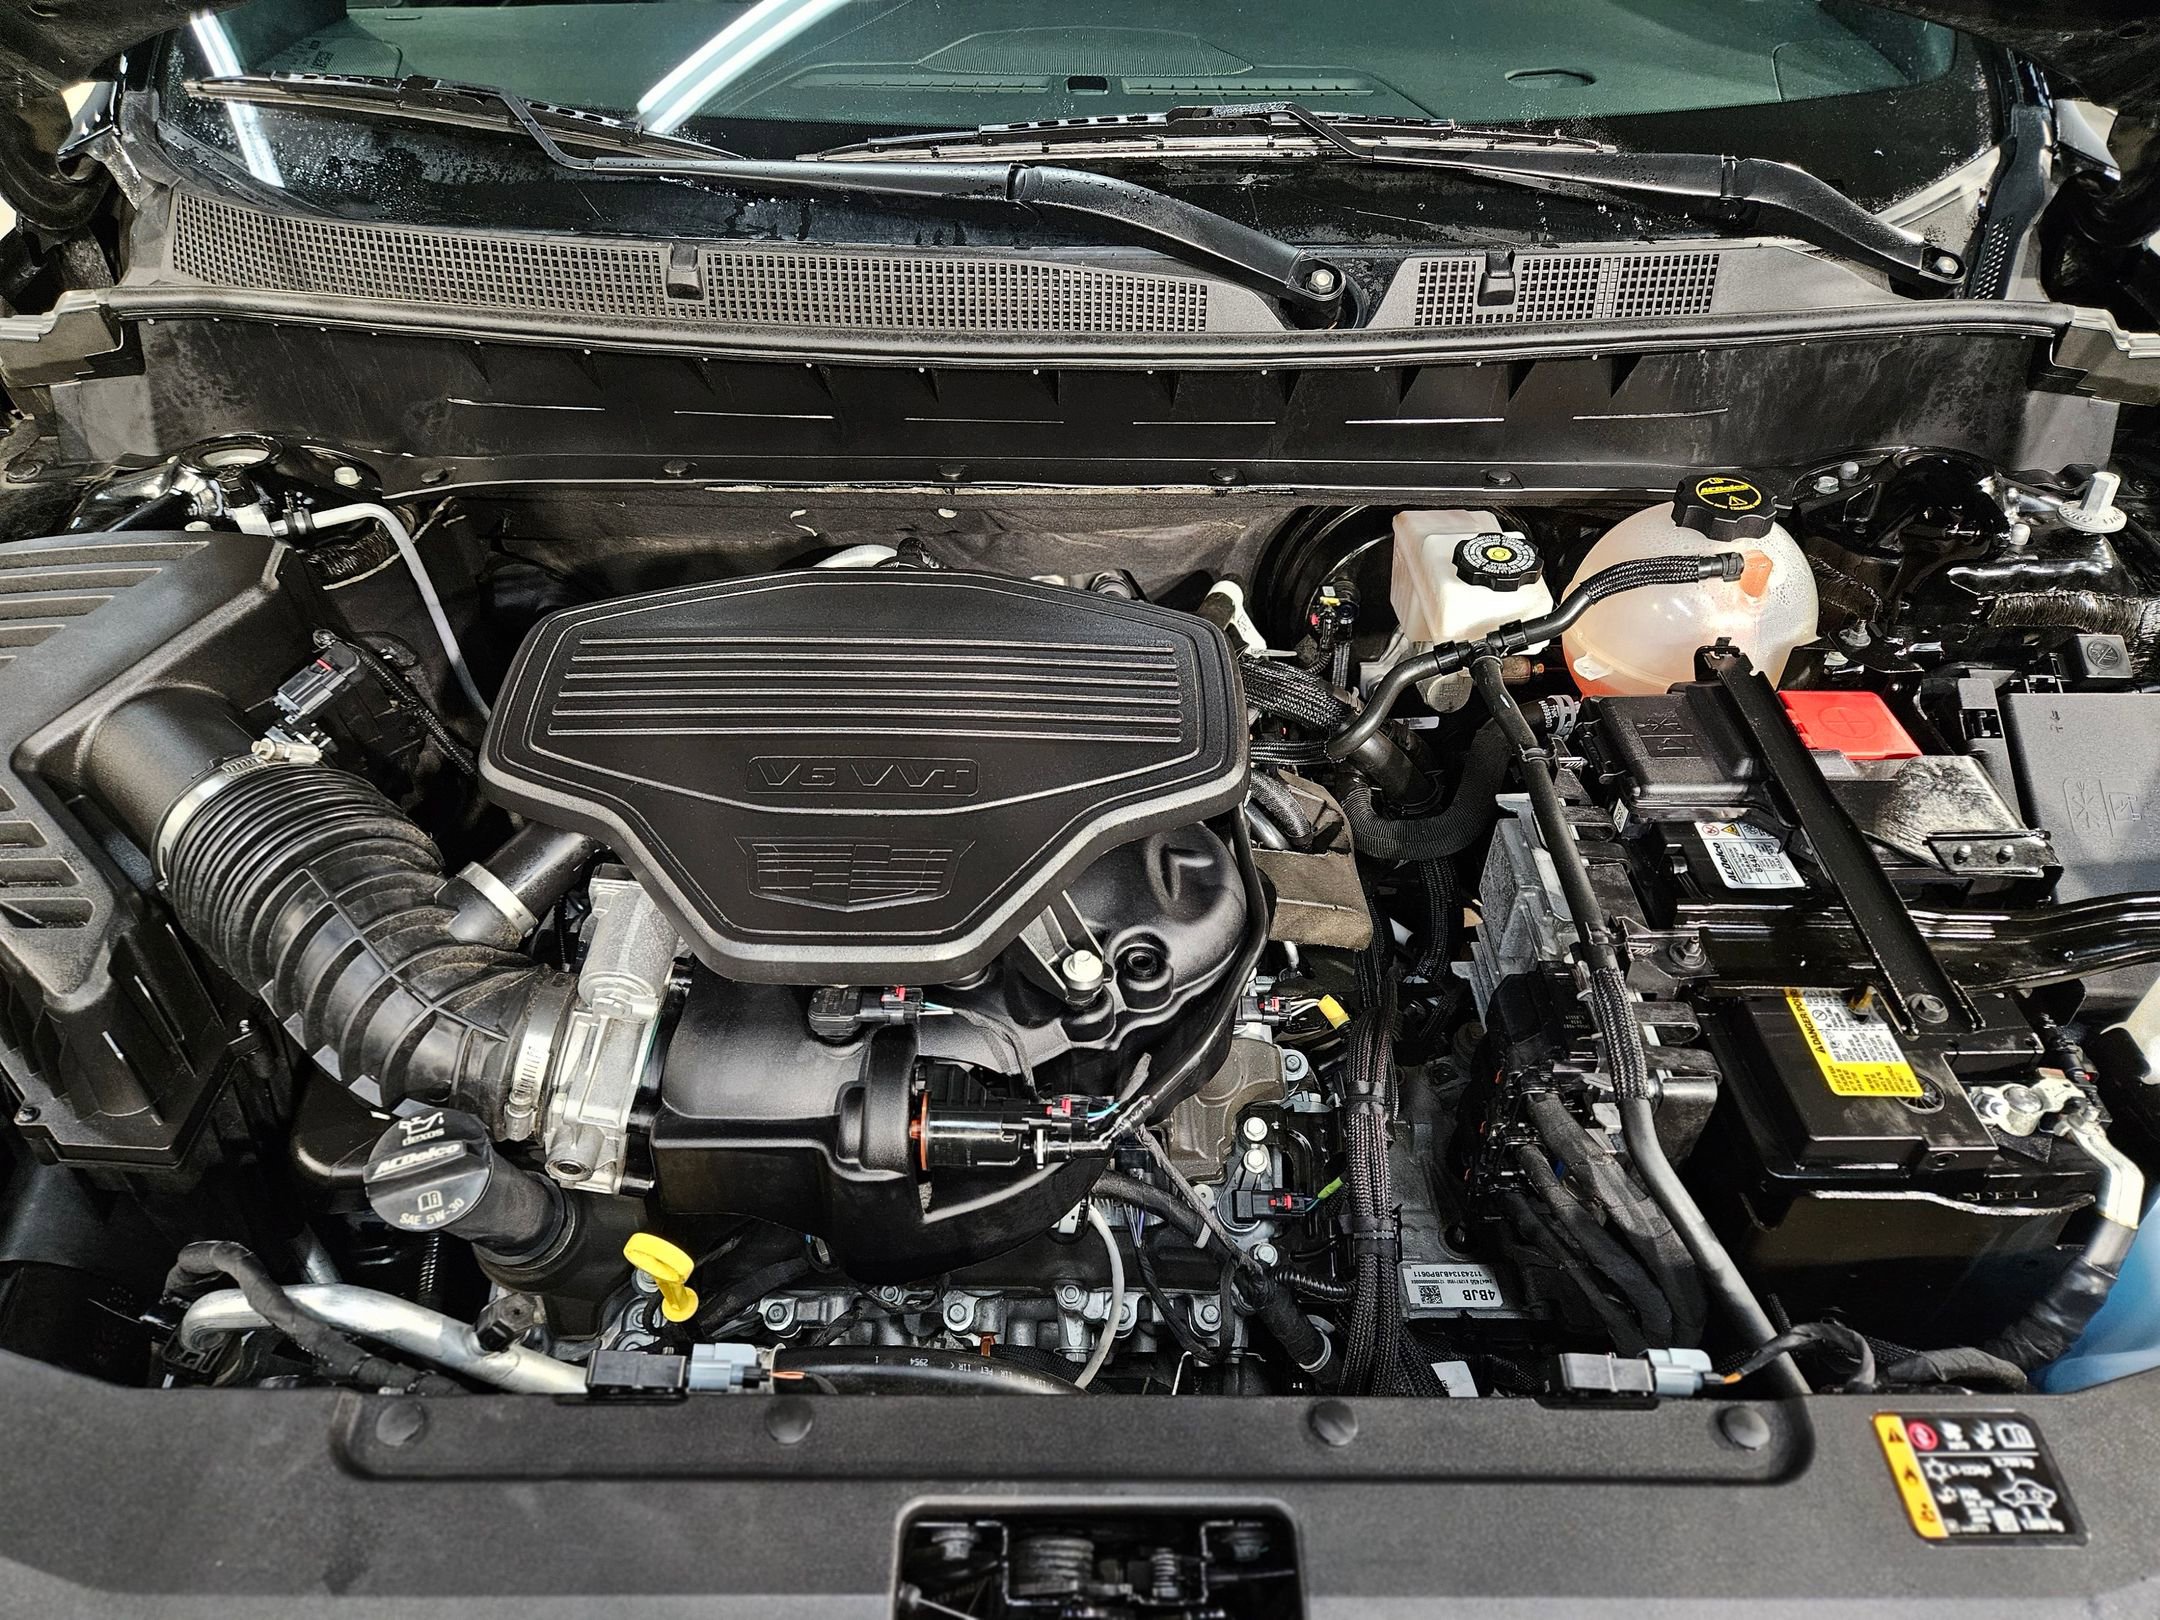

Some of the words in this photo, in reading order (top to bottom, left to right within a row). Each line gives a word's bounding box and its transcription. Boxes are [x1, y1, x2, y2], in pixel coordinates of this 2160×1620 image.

[757, 763, 837, 787] V6
[850, 763, 970, 789] VVT
[1712, 842, 1739, 883] ACDelco
[402, 1128, 445, 1146] dexos
[373, 1143, 461, 1176] ACDelco
[399, 1212, 423, 1226] SAE
[426, 1197, 465, 1225] 5W-30
[1462, 1289, 1496, 1301] 4BJB
[909, 1357, 929, 1367] 2954
